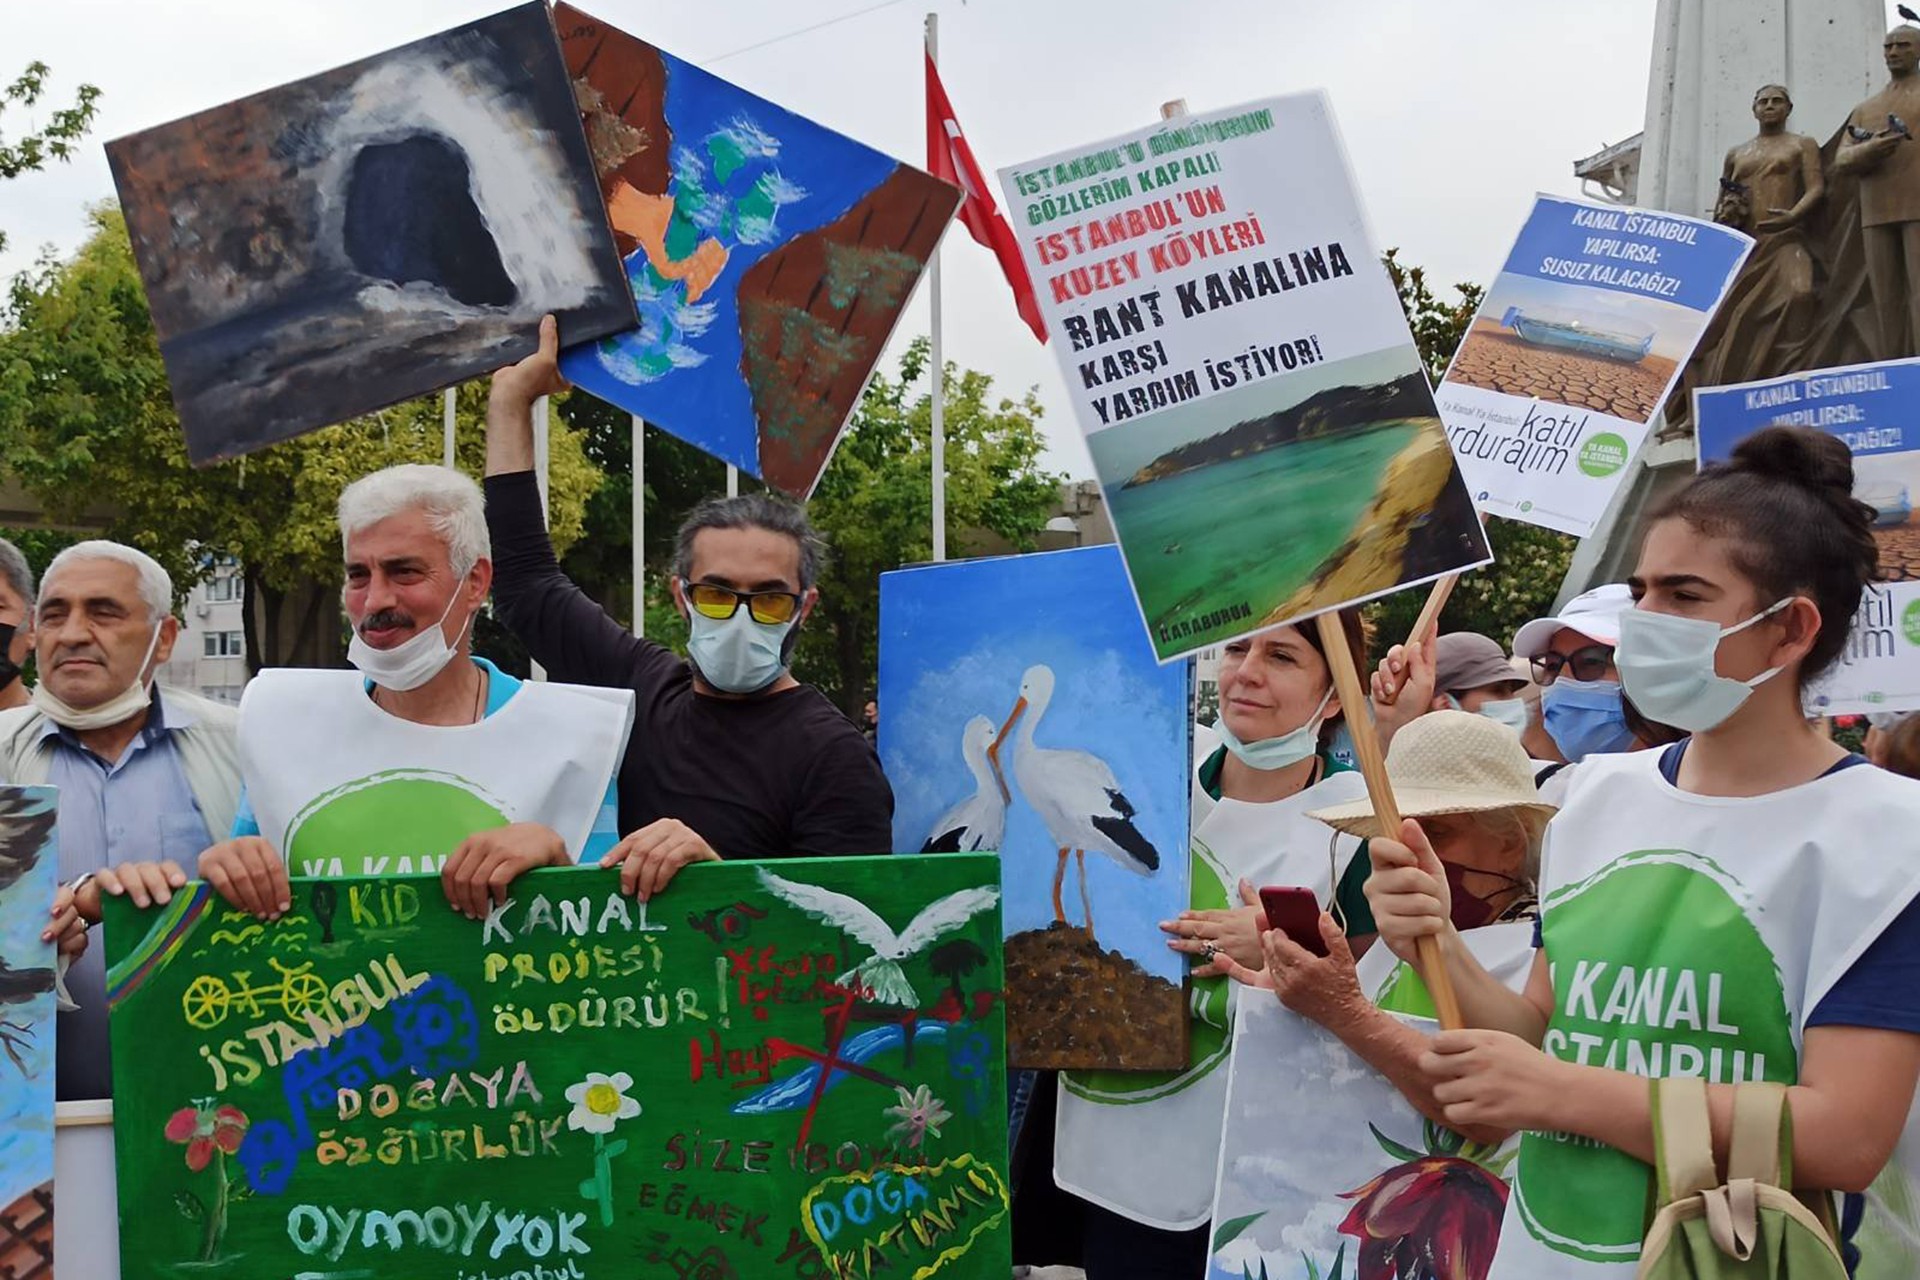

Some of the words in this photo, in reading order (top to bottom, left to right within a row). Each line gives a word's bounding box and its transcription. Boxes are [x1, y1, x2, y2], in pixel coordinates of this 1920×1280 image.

[1027, 176, 1132, 226] GÖZLERİM
[1035, 185, 1226, 265] İSTANBUL'UN
[1572, 208, 1621, 232] KANAL
[1049, 250, 1141, 302] KUZEY
[1150, 211, 1265, 274] KÖYLERİ
[1582, 236, 1662, 265] YAPILIRSA:
[1063, 289, 1164, 351] RANT
[1175, 242, 1354, 318] KANALINA
[1540, 256, 1588, 280] SUSUZ
[1588, 263, 1681, 297] KALACAĞIZ!
[1079, 340, 1169, 390] KARŞI
[1091, 370, 1200, 424] YARDIM
[1203, 334, 1324, 391] İSTİYOR!
[1745, 383, 1801, 410] KANAL
[1518, 404, 1589, 448] katıl
[1159, 602, 1252, 644] KARABURUN
[483, 893, 668, 946] KANAL
[1565, 960, 1739, 1035] KANAL
[639, 1183, 768, 1246] EĞMEK
